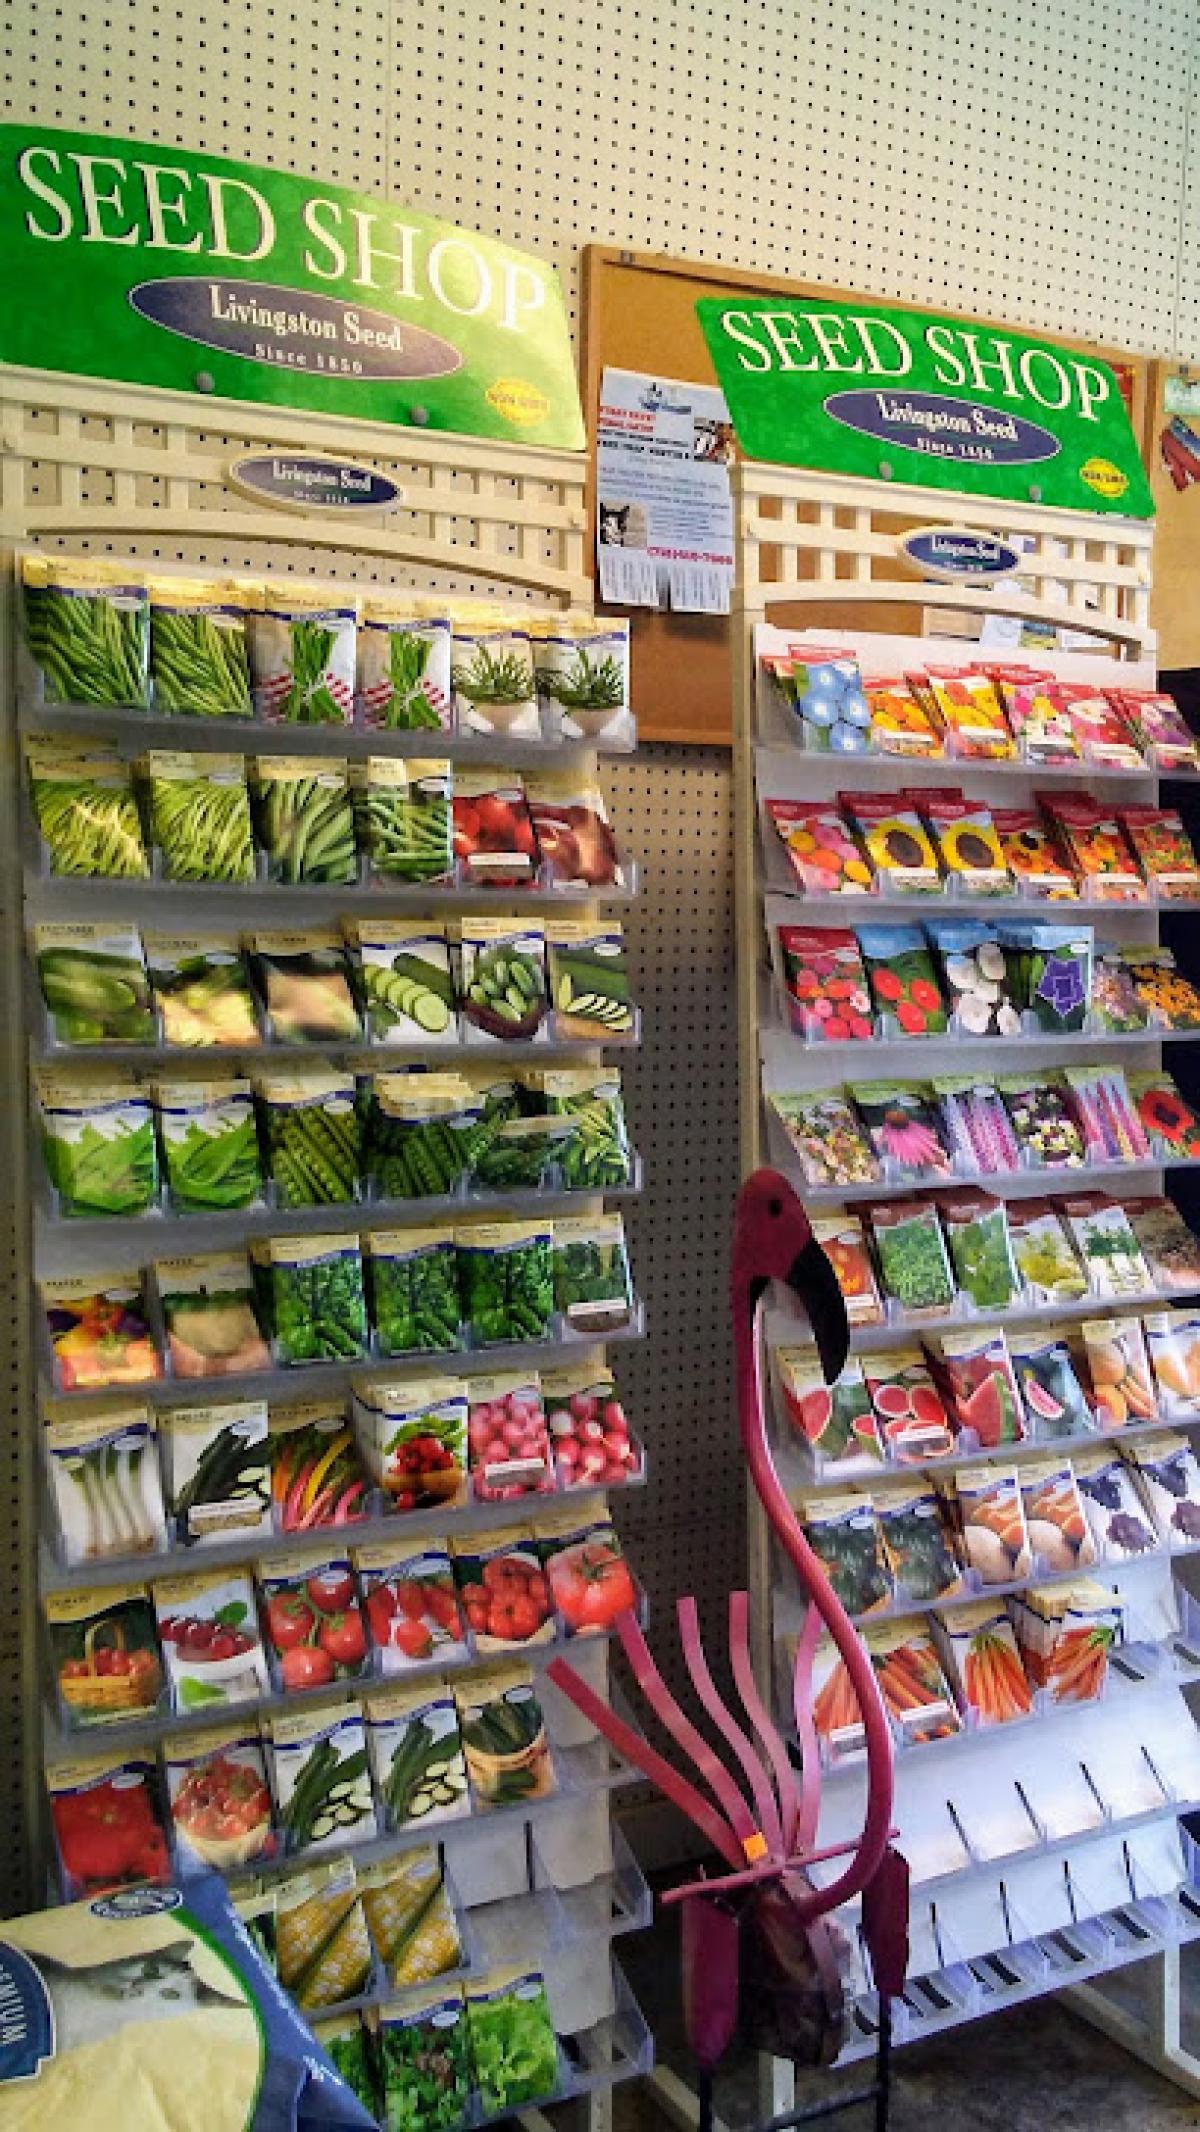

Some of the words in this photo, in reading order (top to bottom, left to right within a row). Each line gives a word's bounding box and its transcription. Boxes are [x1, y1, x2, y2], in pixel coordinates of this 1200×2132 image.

[18, 147, 277, 260] SEED
[302, 198, 546, 331] SHOP
[208, 284, 337, 337] Livingston
[343, 311, 403, 353] Seed
[721, 311, 913, 377] SEED
[925, 325, 1110, 422] SHOP
[875, 393, 972, 433] Livingston
[972, 407, 1019, 441] Seed
